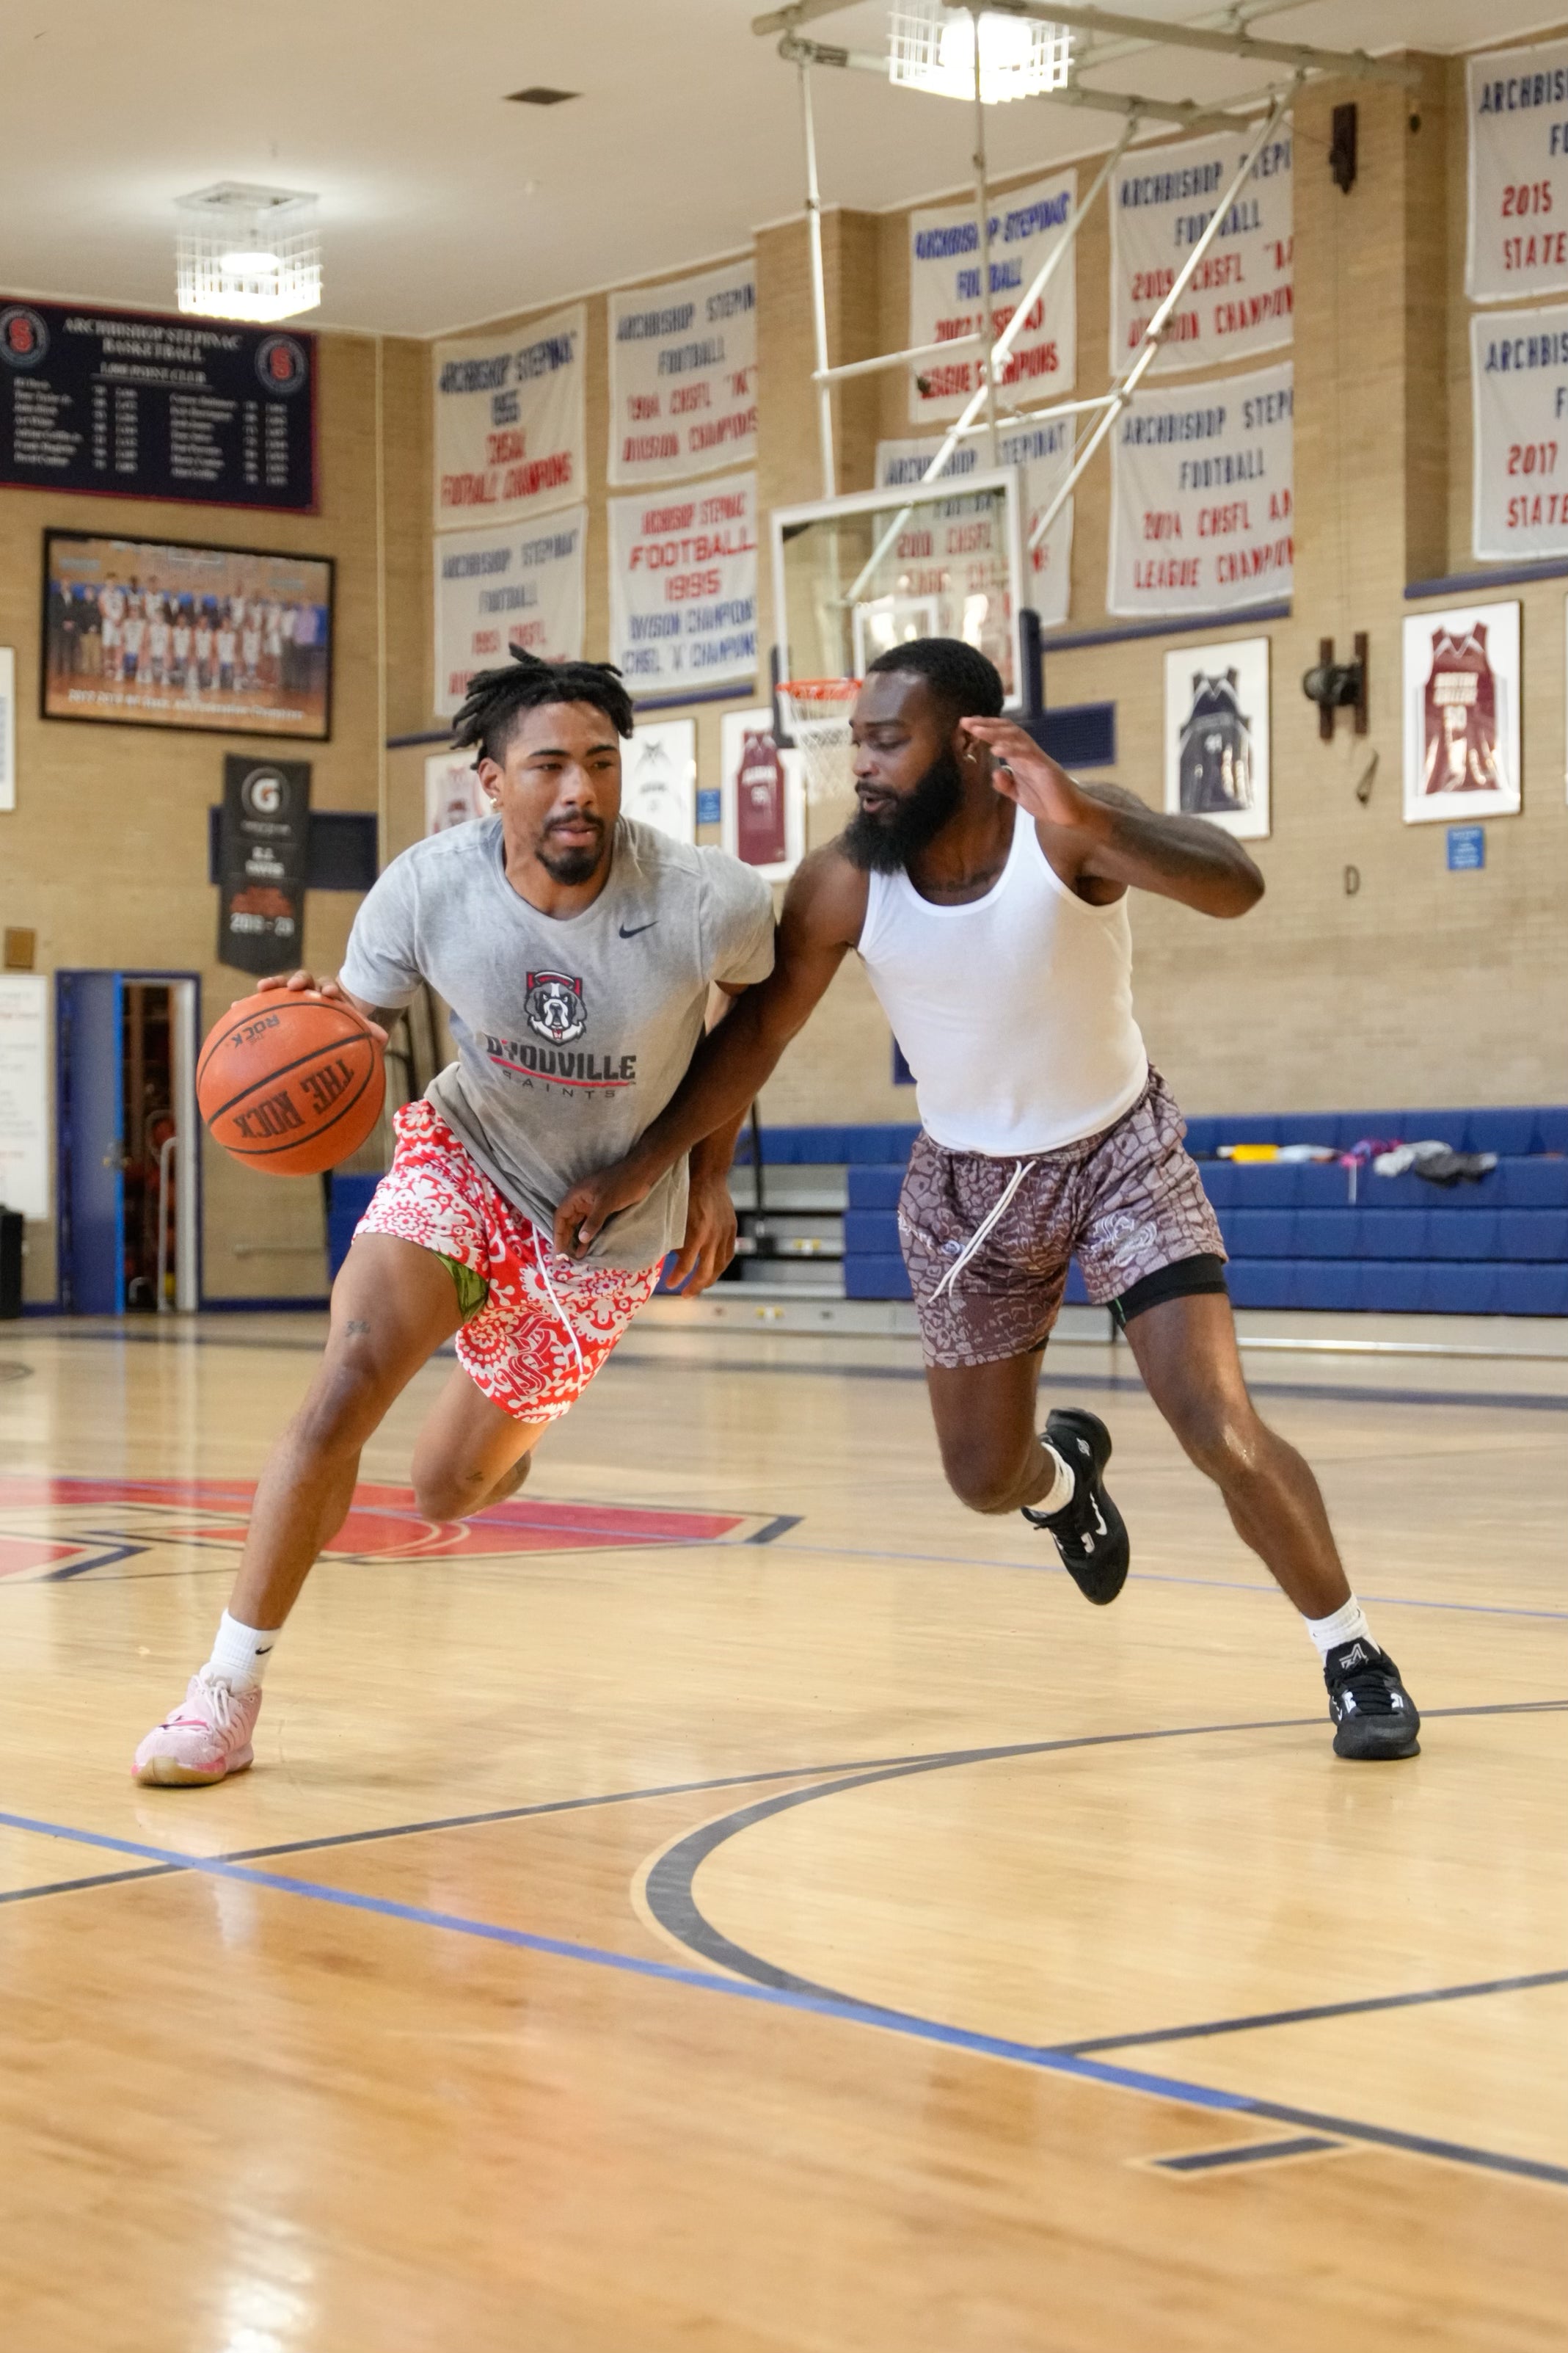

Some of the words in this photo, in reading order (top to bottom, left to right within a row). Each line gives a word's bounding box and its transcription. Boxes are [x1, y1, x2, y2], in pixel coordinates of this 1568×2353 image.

[1479, 70, 1568, 114] ARCHBIS
[1121, 161, 1222, 208] ARCHBISHOP
[1502, 181, 1551, 217] 2015
[1504, 231, 1567, 270] STATE
[1124, 405, 1225, 446] ARCHBISHOP
[1178, 447, 1264, 490] FOOTBALL
[1508, 440, 1558, 476] 2017
[1507, 492, 1568, 528] STATE
[628, 525, 758, 572] FOOTBALL
[231, 1014, 280, 1048] ROCK
[299, 1058, 355, 1116] THE
[232, 1089, 306, 1138] ROCK
